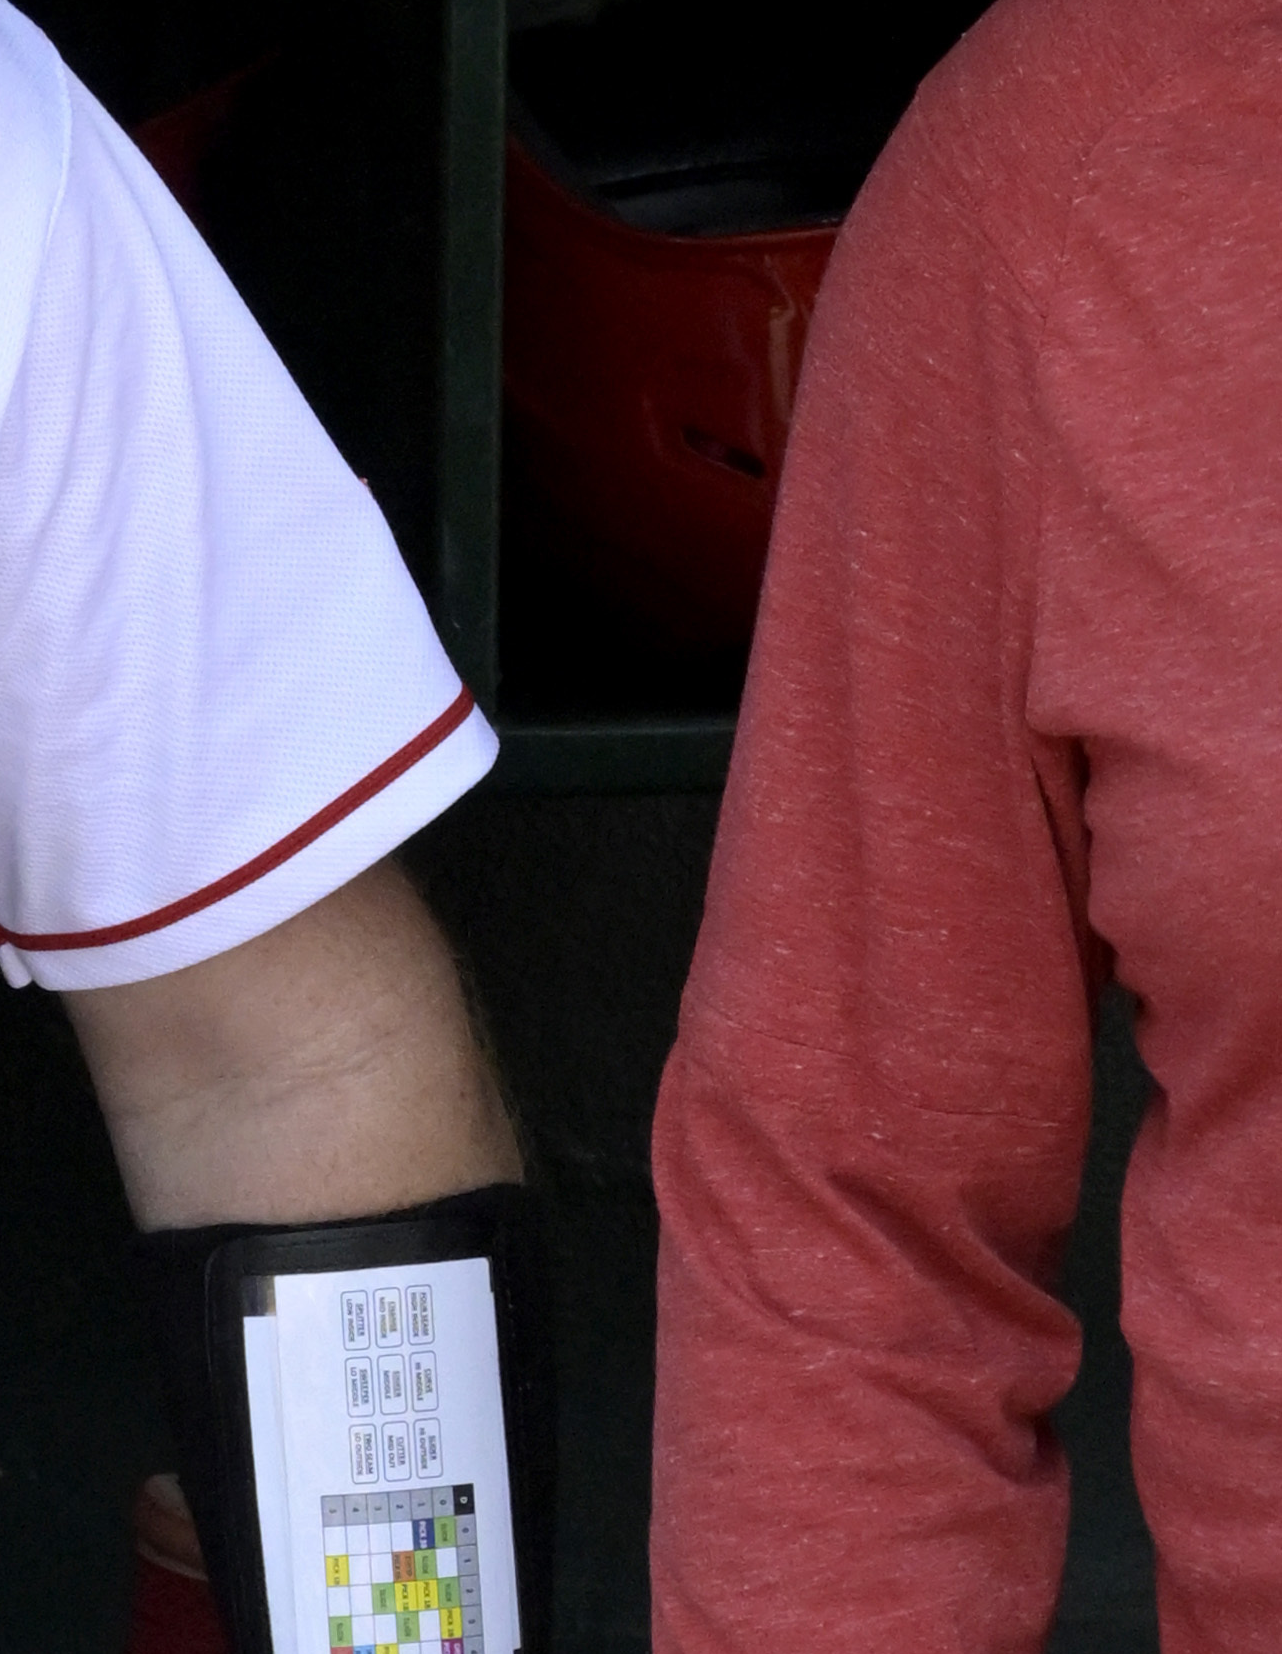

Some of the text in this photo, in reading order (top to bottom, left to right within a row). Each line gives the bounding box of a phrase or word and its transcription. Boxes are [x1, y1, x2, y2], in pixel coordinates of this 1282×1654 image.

[356, 1304, 365, 1336] SPLITTER
[360, 1369, 369, 1404] SWEEPER
[416, 1372, 424, 1401] MIDDLE
[424, 1369, 433, 1393] CURVE
[364, 1433, 374, 1474] TWO SEAM
[396, 1437, 405, 1465] CUTTER
[420, 1438, 428, 1469] OUTSIDE
